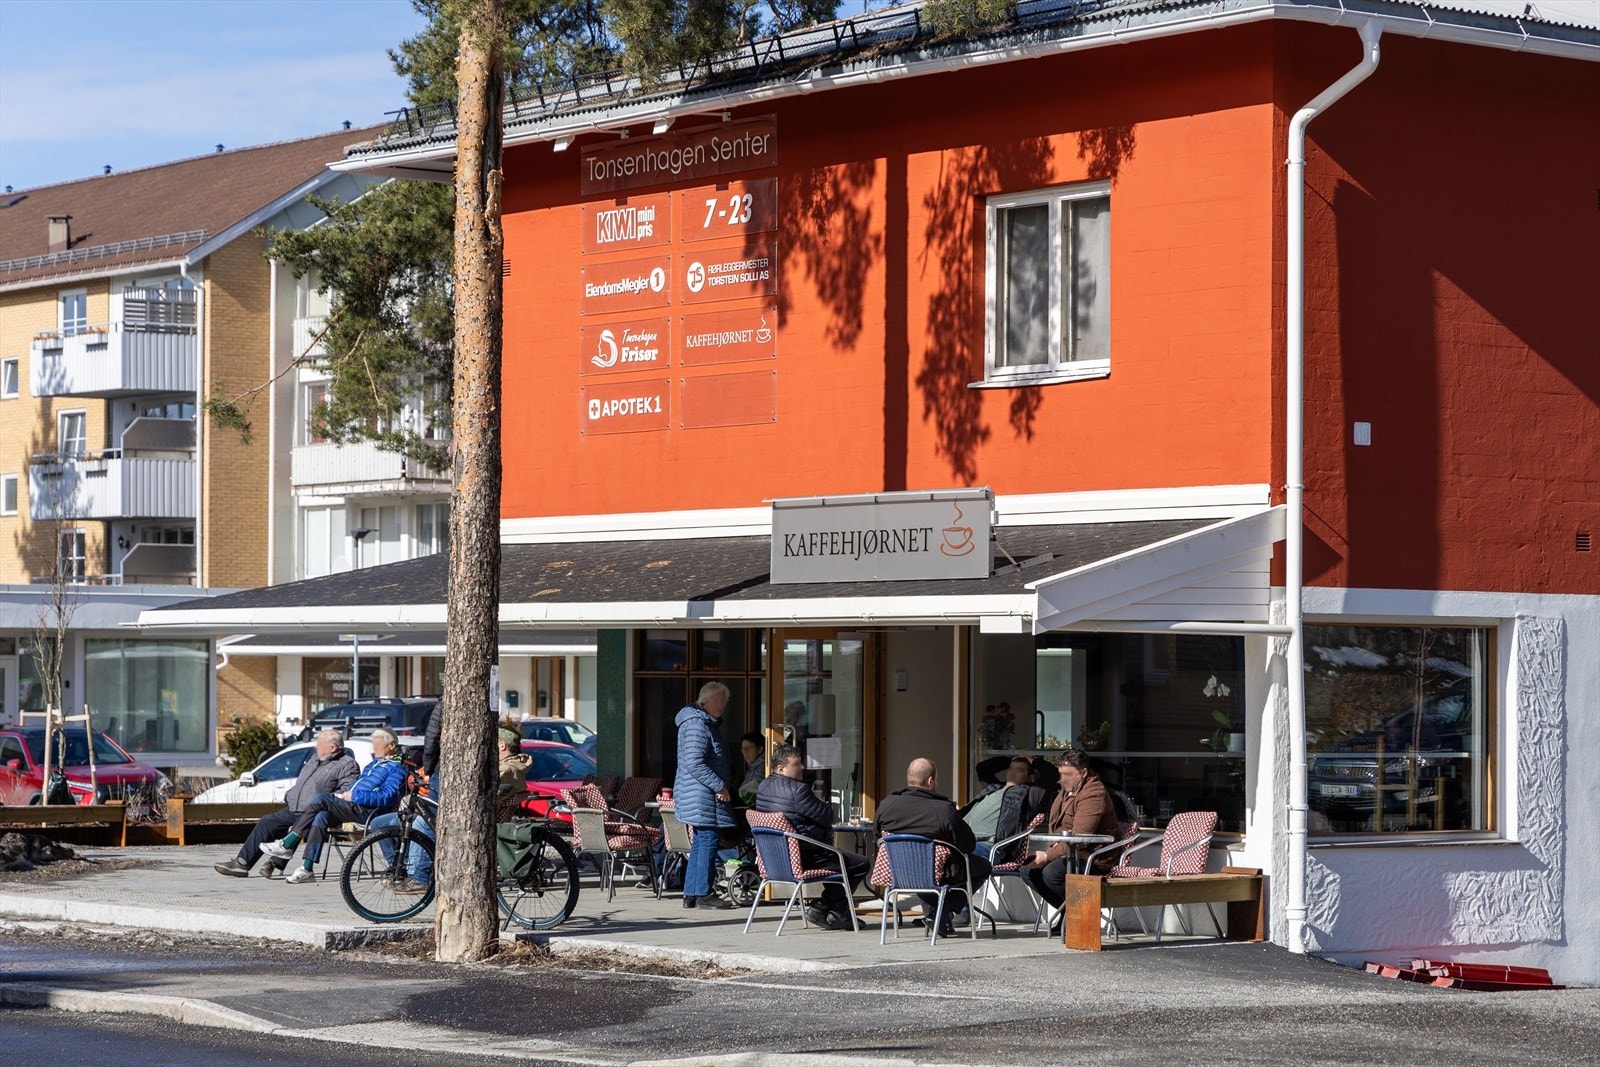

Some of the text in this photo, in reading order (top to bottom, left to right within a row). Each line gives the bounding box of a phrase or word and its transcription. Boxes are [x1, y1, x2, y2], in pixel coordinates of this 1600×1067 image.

[586, 131, 771, 181] Tonsenhagen Senter
[595, 204, 656, 244] KIWI mini
[637, 222, 654, 241] pris
[707, 258, 769, 275] RØRLEGGERMESTER
[707, 270, 769, 287] TORSTEIN SOLLI AS
[686, 329, 754, 348] KAFFEHJØRNET
[620, 346, 659, 363] Frisør
[783, 527, 933, 561] KAFFEHJØRNET
